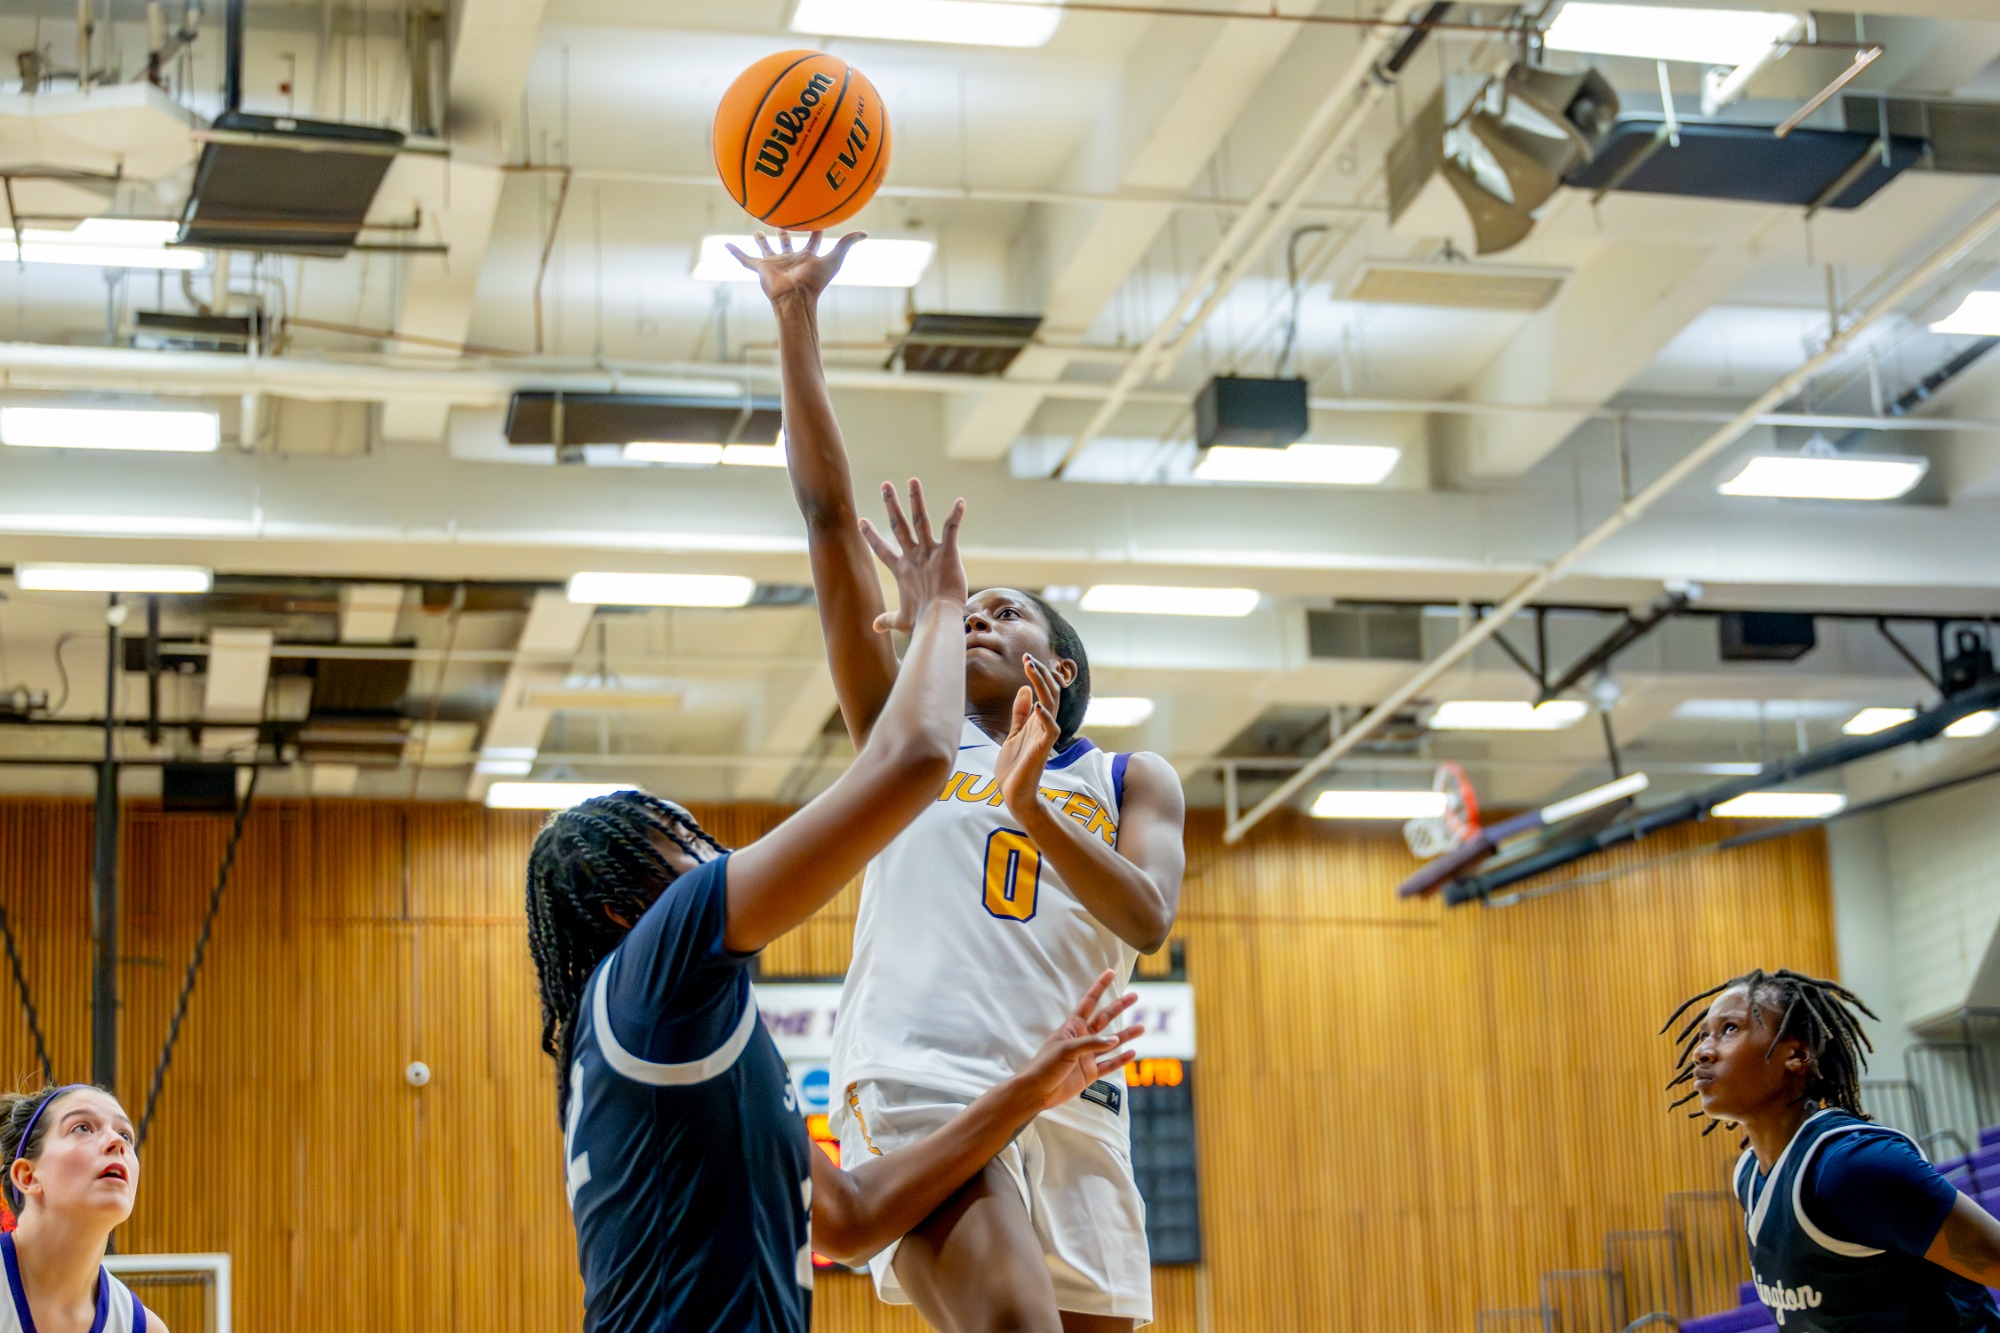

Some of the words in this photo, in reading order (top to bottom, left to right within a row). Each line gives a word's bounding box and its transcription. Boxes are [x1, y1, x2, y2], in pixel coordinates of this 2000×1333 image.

[753, 71, 836, 179] Wilson
[937, 770, 1118, 847] HUTER
[981, 826, 1043, 924] 0
